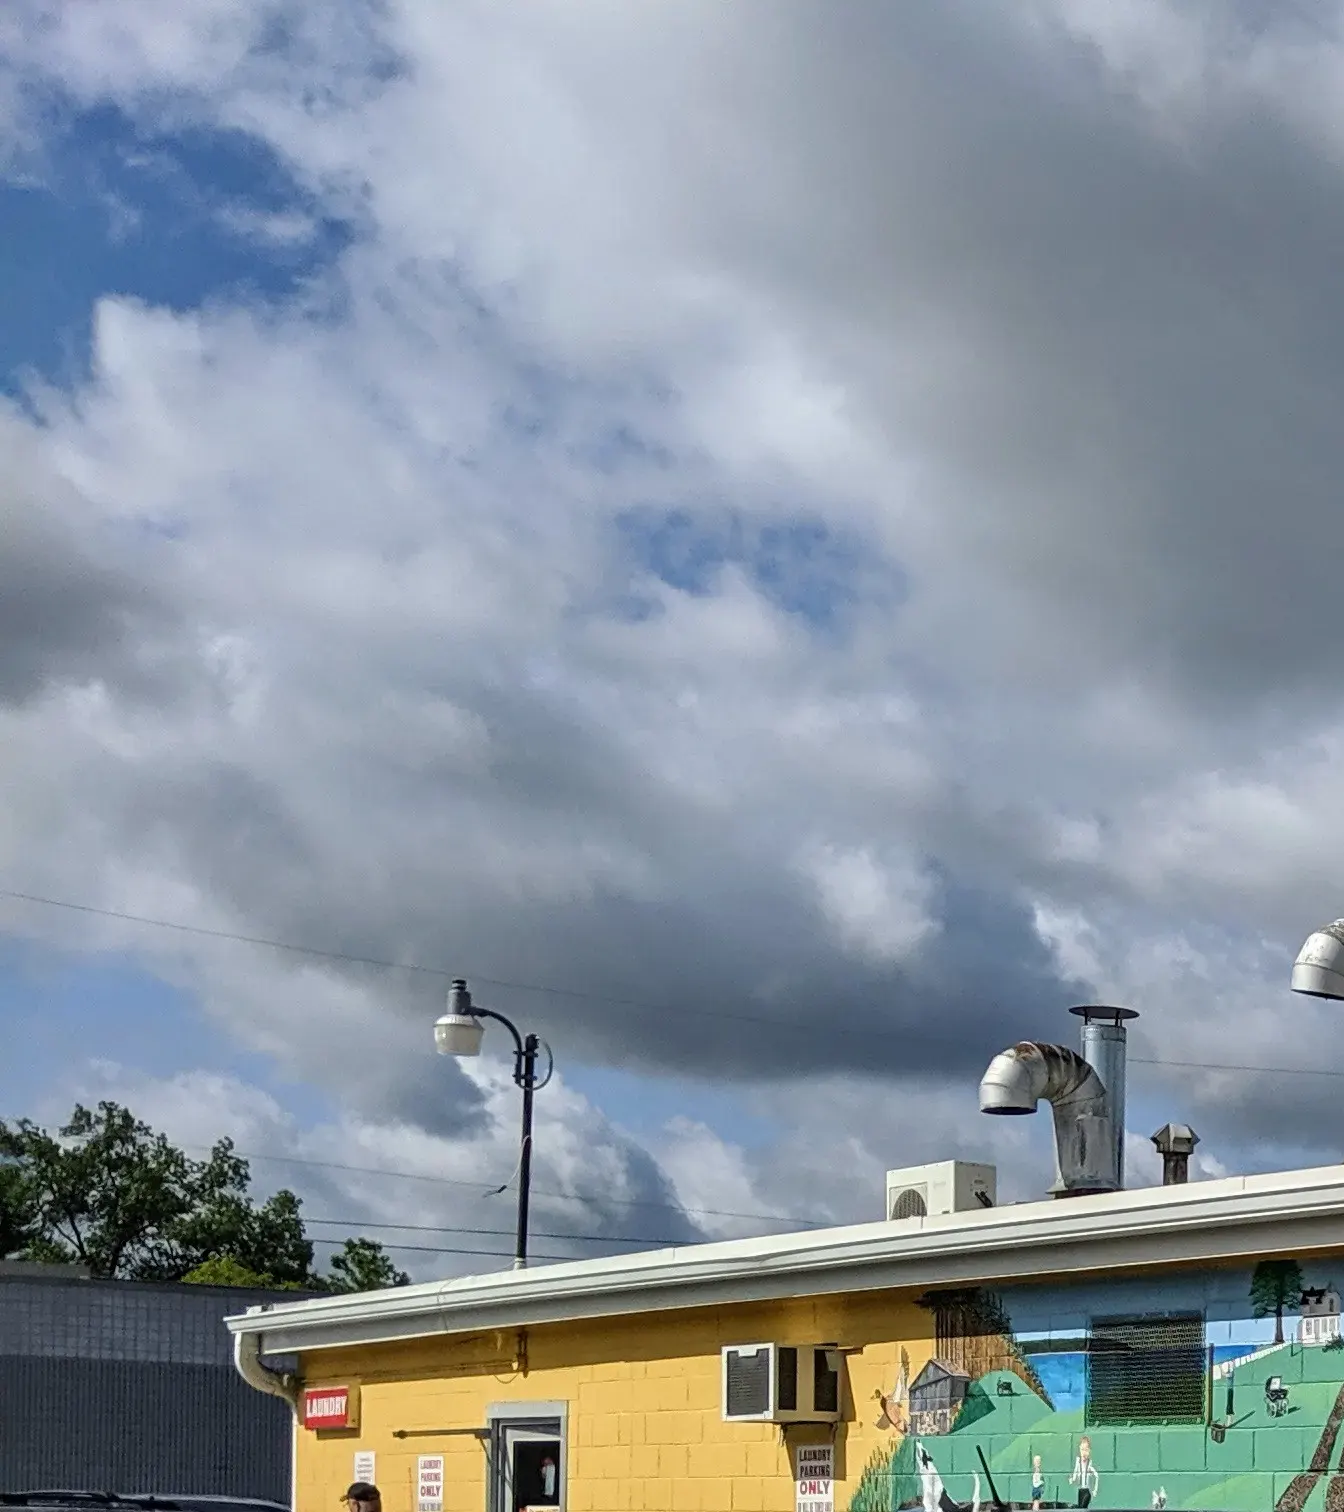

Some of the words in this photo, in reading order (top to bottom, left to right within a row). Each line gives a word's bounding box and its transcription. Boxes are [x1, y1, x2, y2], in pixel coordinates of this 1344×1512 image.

[306, 1395, 348, 1418] LAUNDRY
[799, 1448, 831, 1461] LAUNDRY
[799, 1464, 831, 1478] PARKING
[420, 1484, 442, 1497] ONLY
[799, 1480, 831, 1495] ONLY
